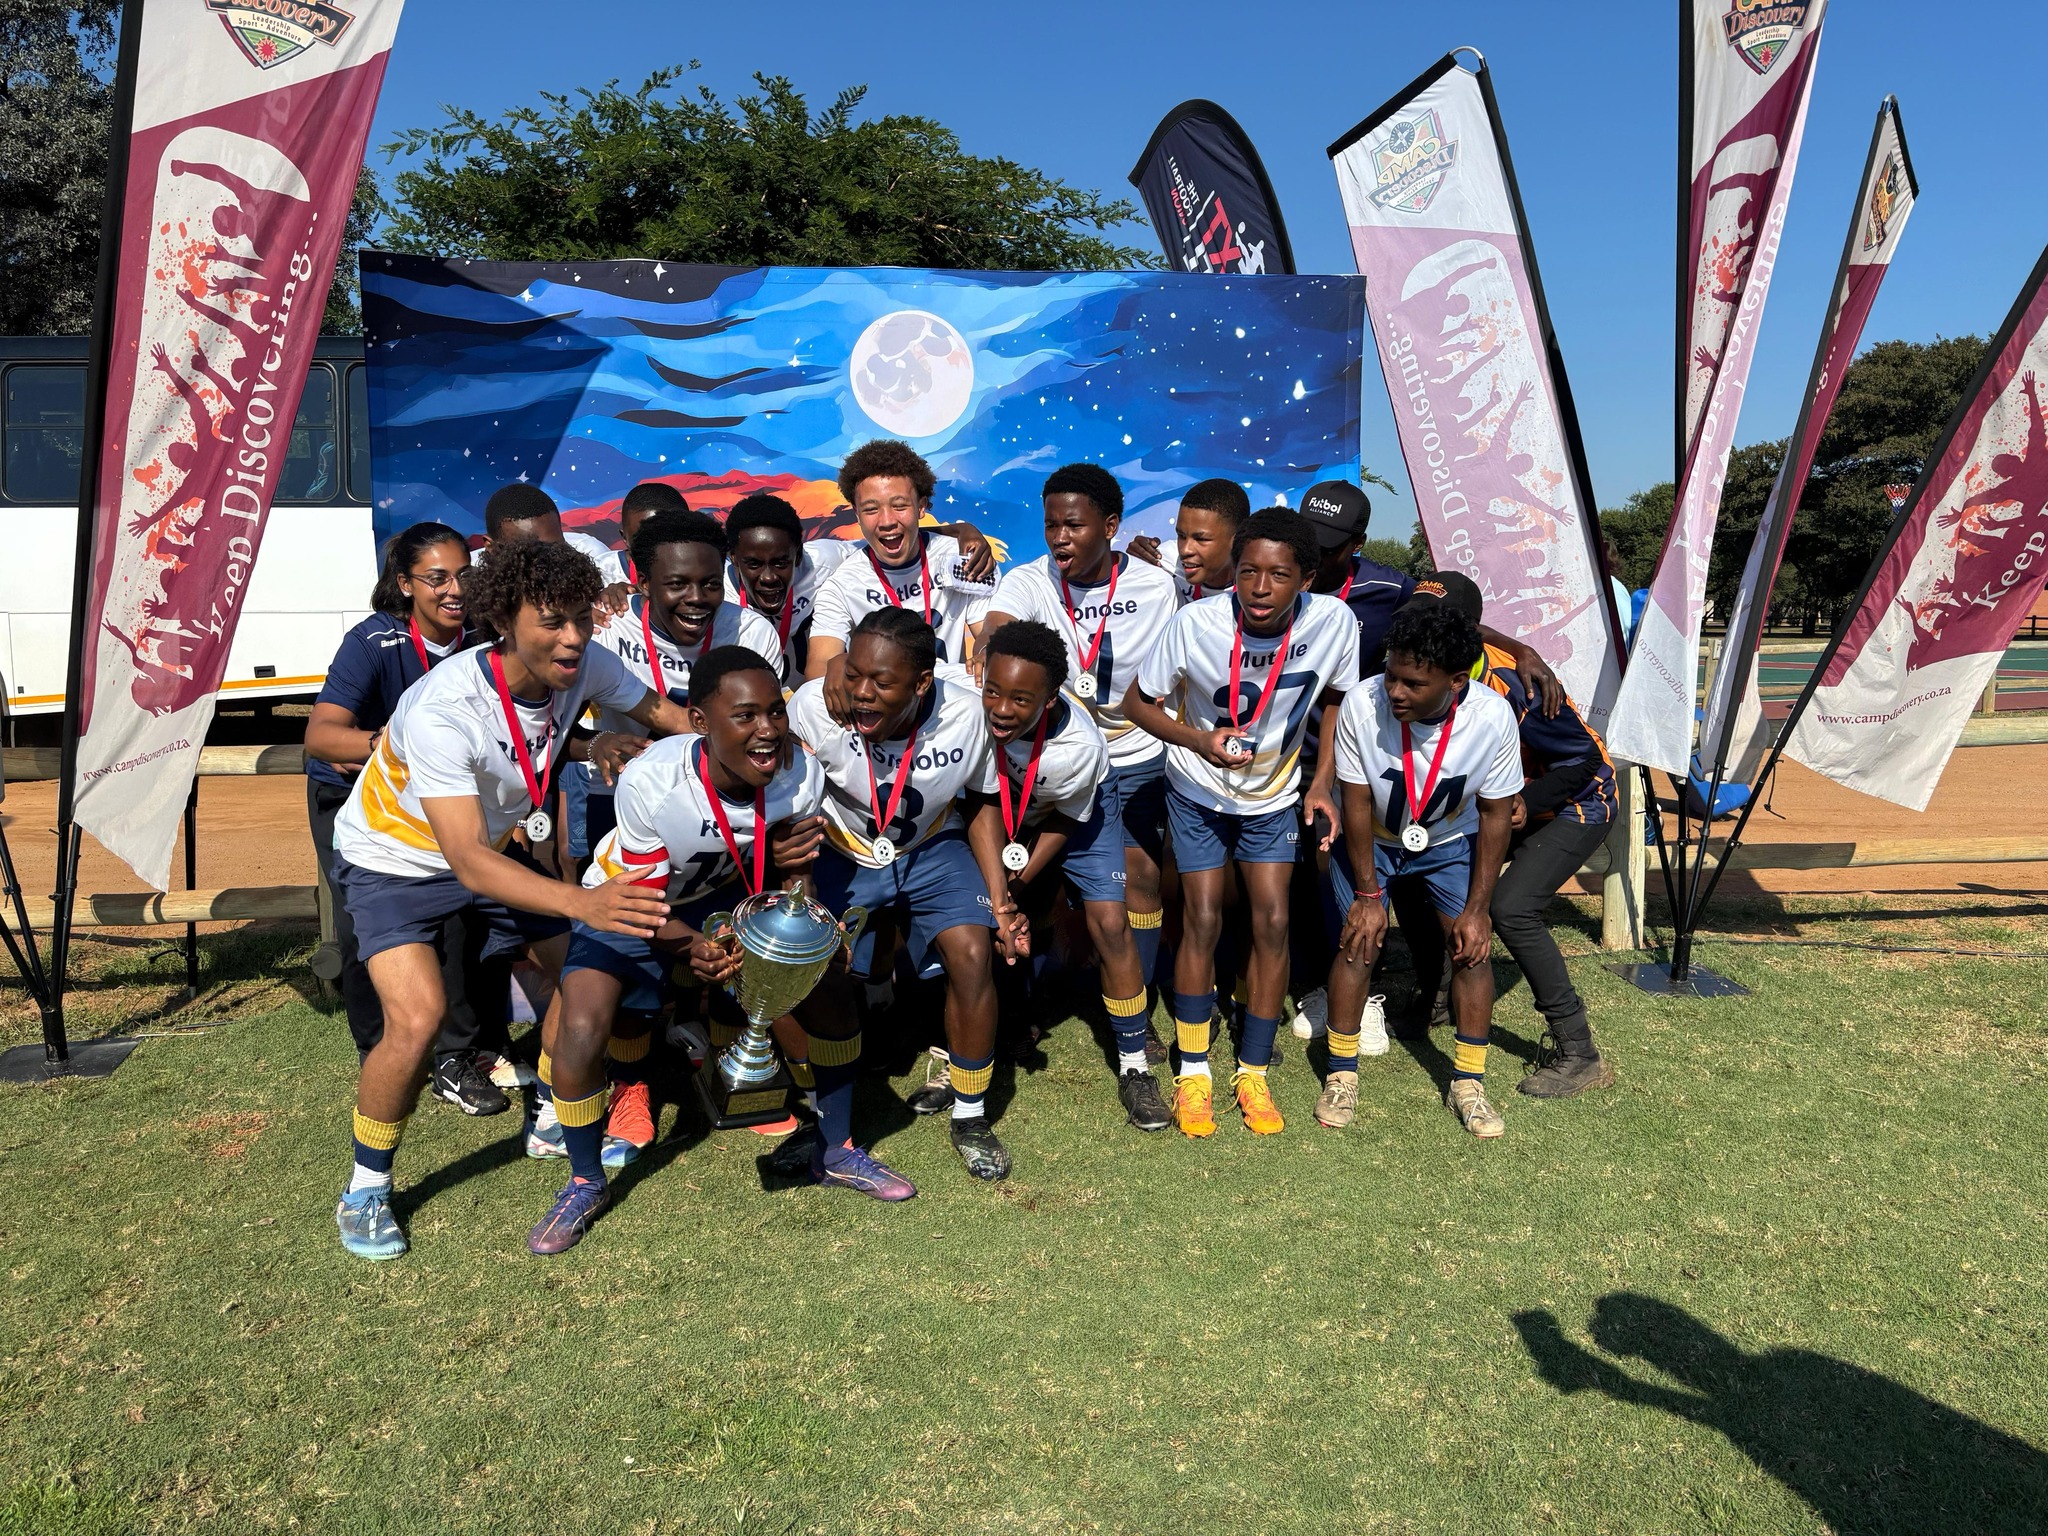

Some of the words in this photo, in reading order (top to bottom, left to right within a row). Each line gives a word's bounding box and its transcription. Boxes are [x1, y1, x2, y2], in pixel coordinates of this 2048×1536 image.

[238, 17, 258, 28] Sport
[266, 24, 302, 43] Adventure
[252, 13, 291, 31] Leadership
[1729, 6, 1806, 37] Discovery
[1309, 497, 1342, 514] Futbol
[1310, 508, 1334, 517] ALLIANCE
[1971, 531, 2047, 612] Keep
[1088, 631, 1113, 705] 1
[1229, 643, 1308, 668] Mutle
[1817, 686, 1952, 725] www.campdiscovery.co.za
[1379, 767, 1467, 837] 14
